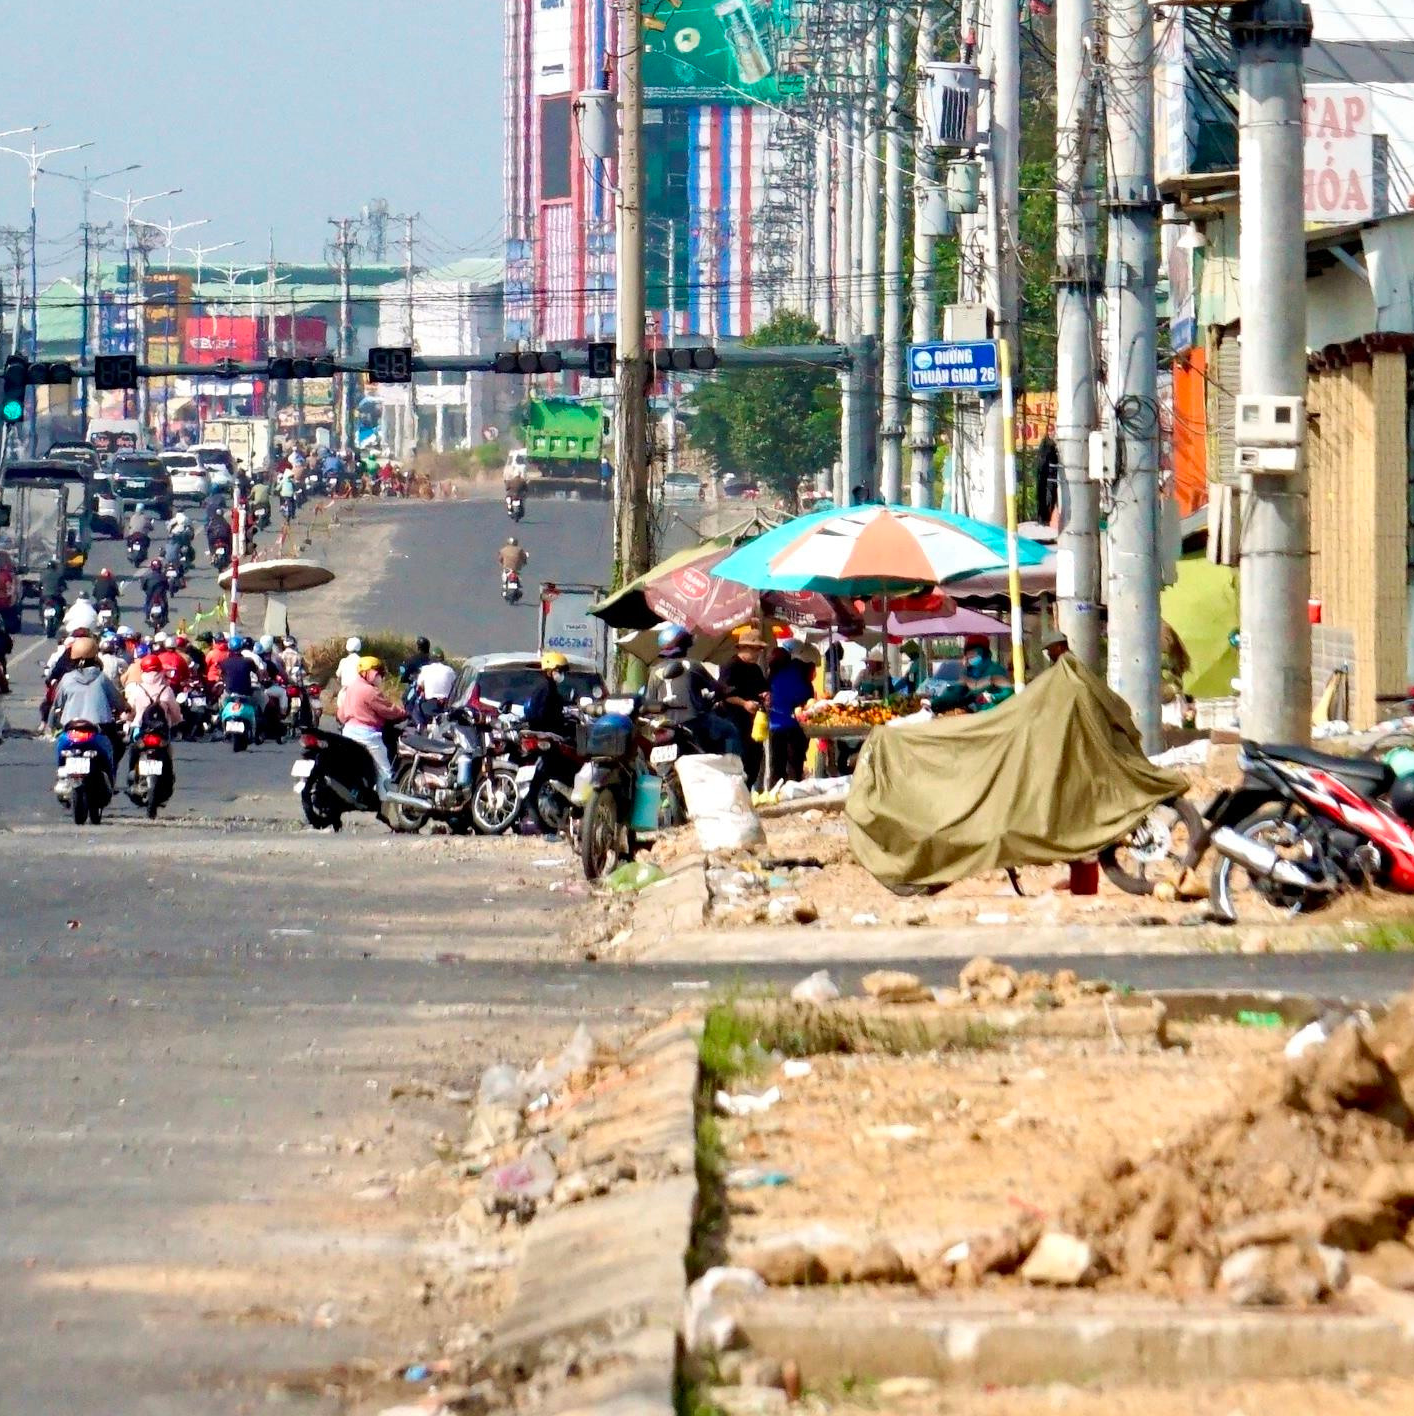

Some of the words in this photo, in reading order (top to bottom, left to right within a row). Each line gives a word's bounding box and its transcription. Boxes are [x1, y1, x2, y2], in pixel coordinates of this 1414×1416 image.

[934, 347, 974, 365] ĐƯỜNG
[951, 367, 978, 384] GIAO
[980, 366, 996, 383] 26
